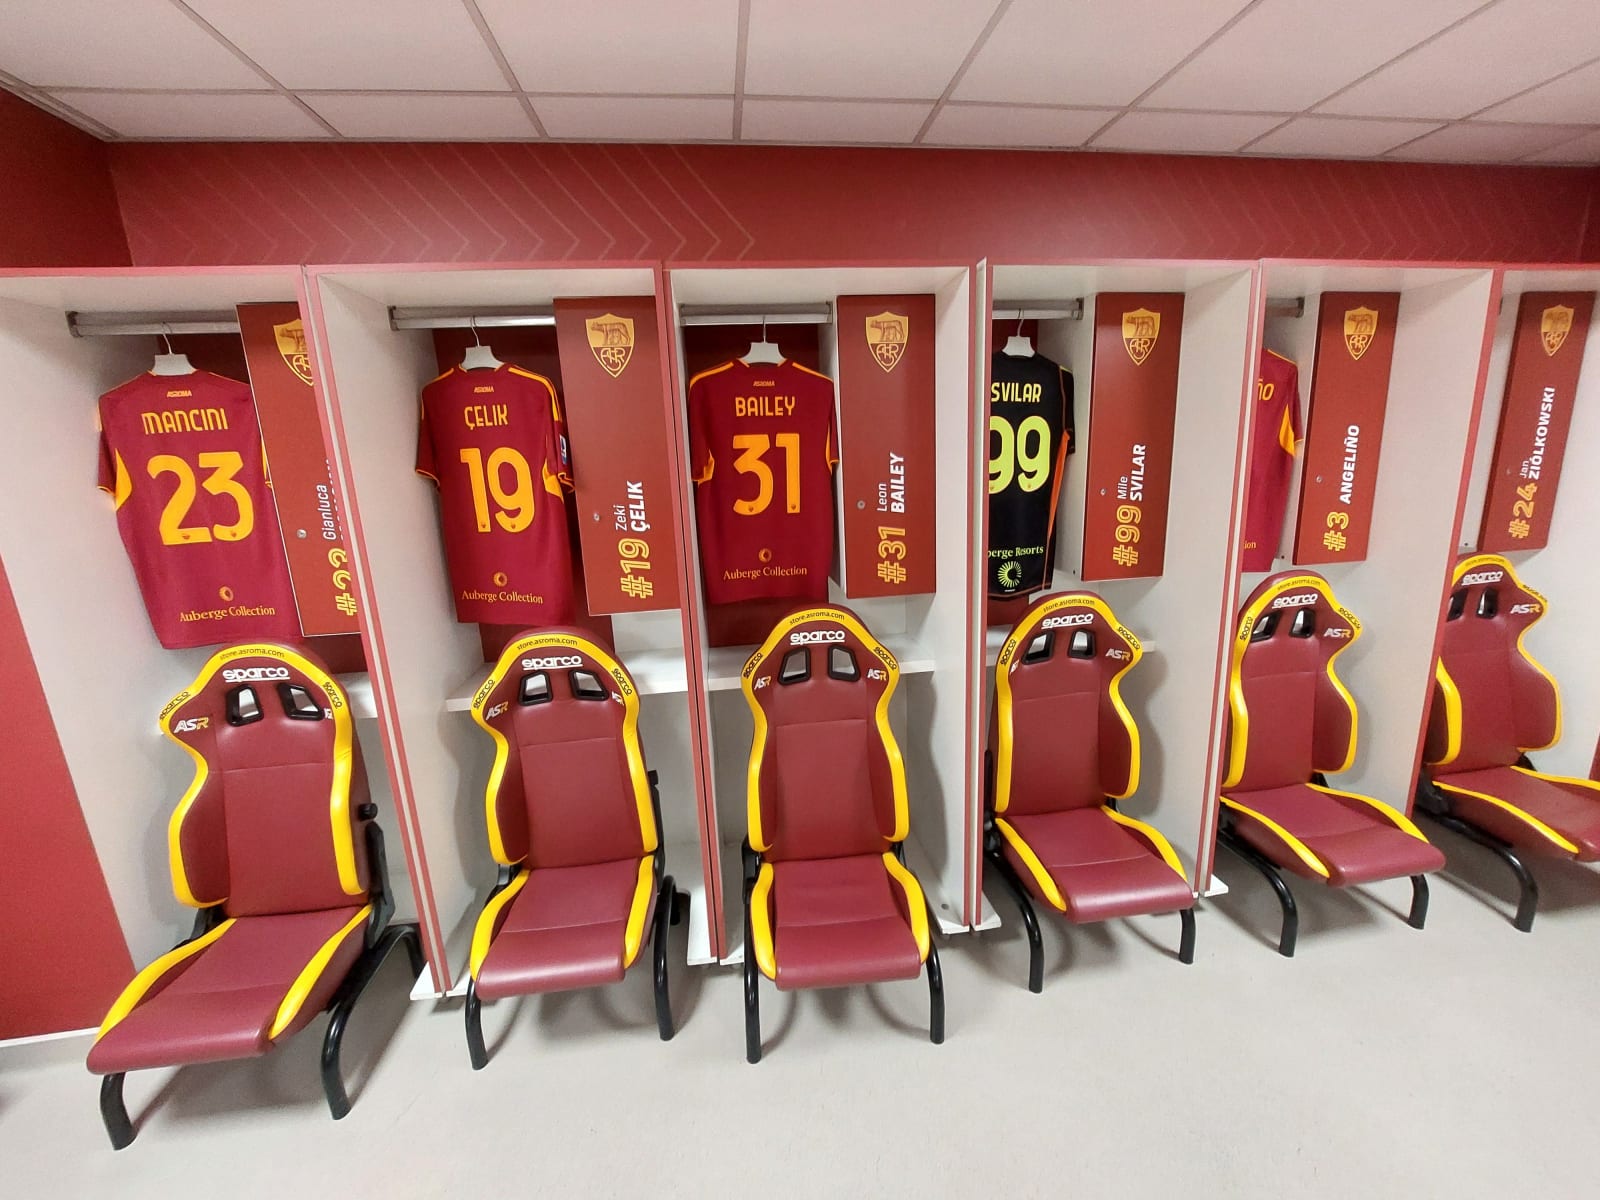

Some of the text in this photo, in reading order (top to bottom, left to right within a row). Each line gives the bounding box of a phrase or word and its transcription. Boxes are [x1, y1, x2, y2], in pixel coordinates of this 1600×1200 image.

[990, 382, 1042, 404] SVILAR
[464, 404, 508, 430] ÇELIK
[735, 396, 795, 417] BAILEY
[141, 408, 229, 435] MANCINI
[989, 416, 1051, 495] 99
[732, 433, 801, 516] 31
[1130, 443, 1146, 501] SVILAR
[460, 447, 536, 533] 19
[890, 452, 905, 514] BAILEY
[1322, 424, 1360, 552] #3 ANGELIÑO
[147, 451, 255, 546] 23
[626, 480, 650, 533] ÇELIK
[1508, 460, 1538, 539] #24 Jan
[316, 484, 337, 541] Gianluca
[1112, 475, 1142, 567] #99 Mile
[877, 482, 907, 584] #31 Leon
[615, 504, 653, 599] #19 Zeki
[723, 565, 808, 580] Auberge Collection
[461, 589, 544, 604] Auberge Collection
[1272, 593, 1318, 609] sparco
[179, 605, 276, 622] Auberge Collection
[789, 611, 845, 626] store.asroma.com
[1041, 613, 1095, 629] sparco
[790, 630, 845, 646] sparco
[1324, 627, 1351, 638] ASR
[219, 647, 285, 661] store.asroma.com
[516, 637, 578, 651] store.asroma.com
[522, 655, 583, 671] sparco
[1105, 648, 1131, 662] ASR
[222, 667, 290, 682] sparco
[611, 668, 633, 696] sparco
[754, 675, 772, 691] ASR
[867, 668, 887, 681] ASR
[322, 681, 343, 709] sparco
[485, 701, 509, 721] ASR
[173, 716, 209, 734] ASR
